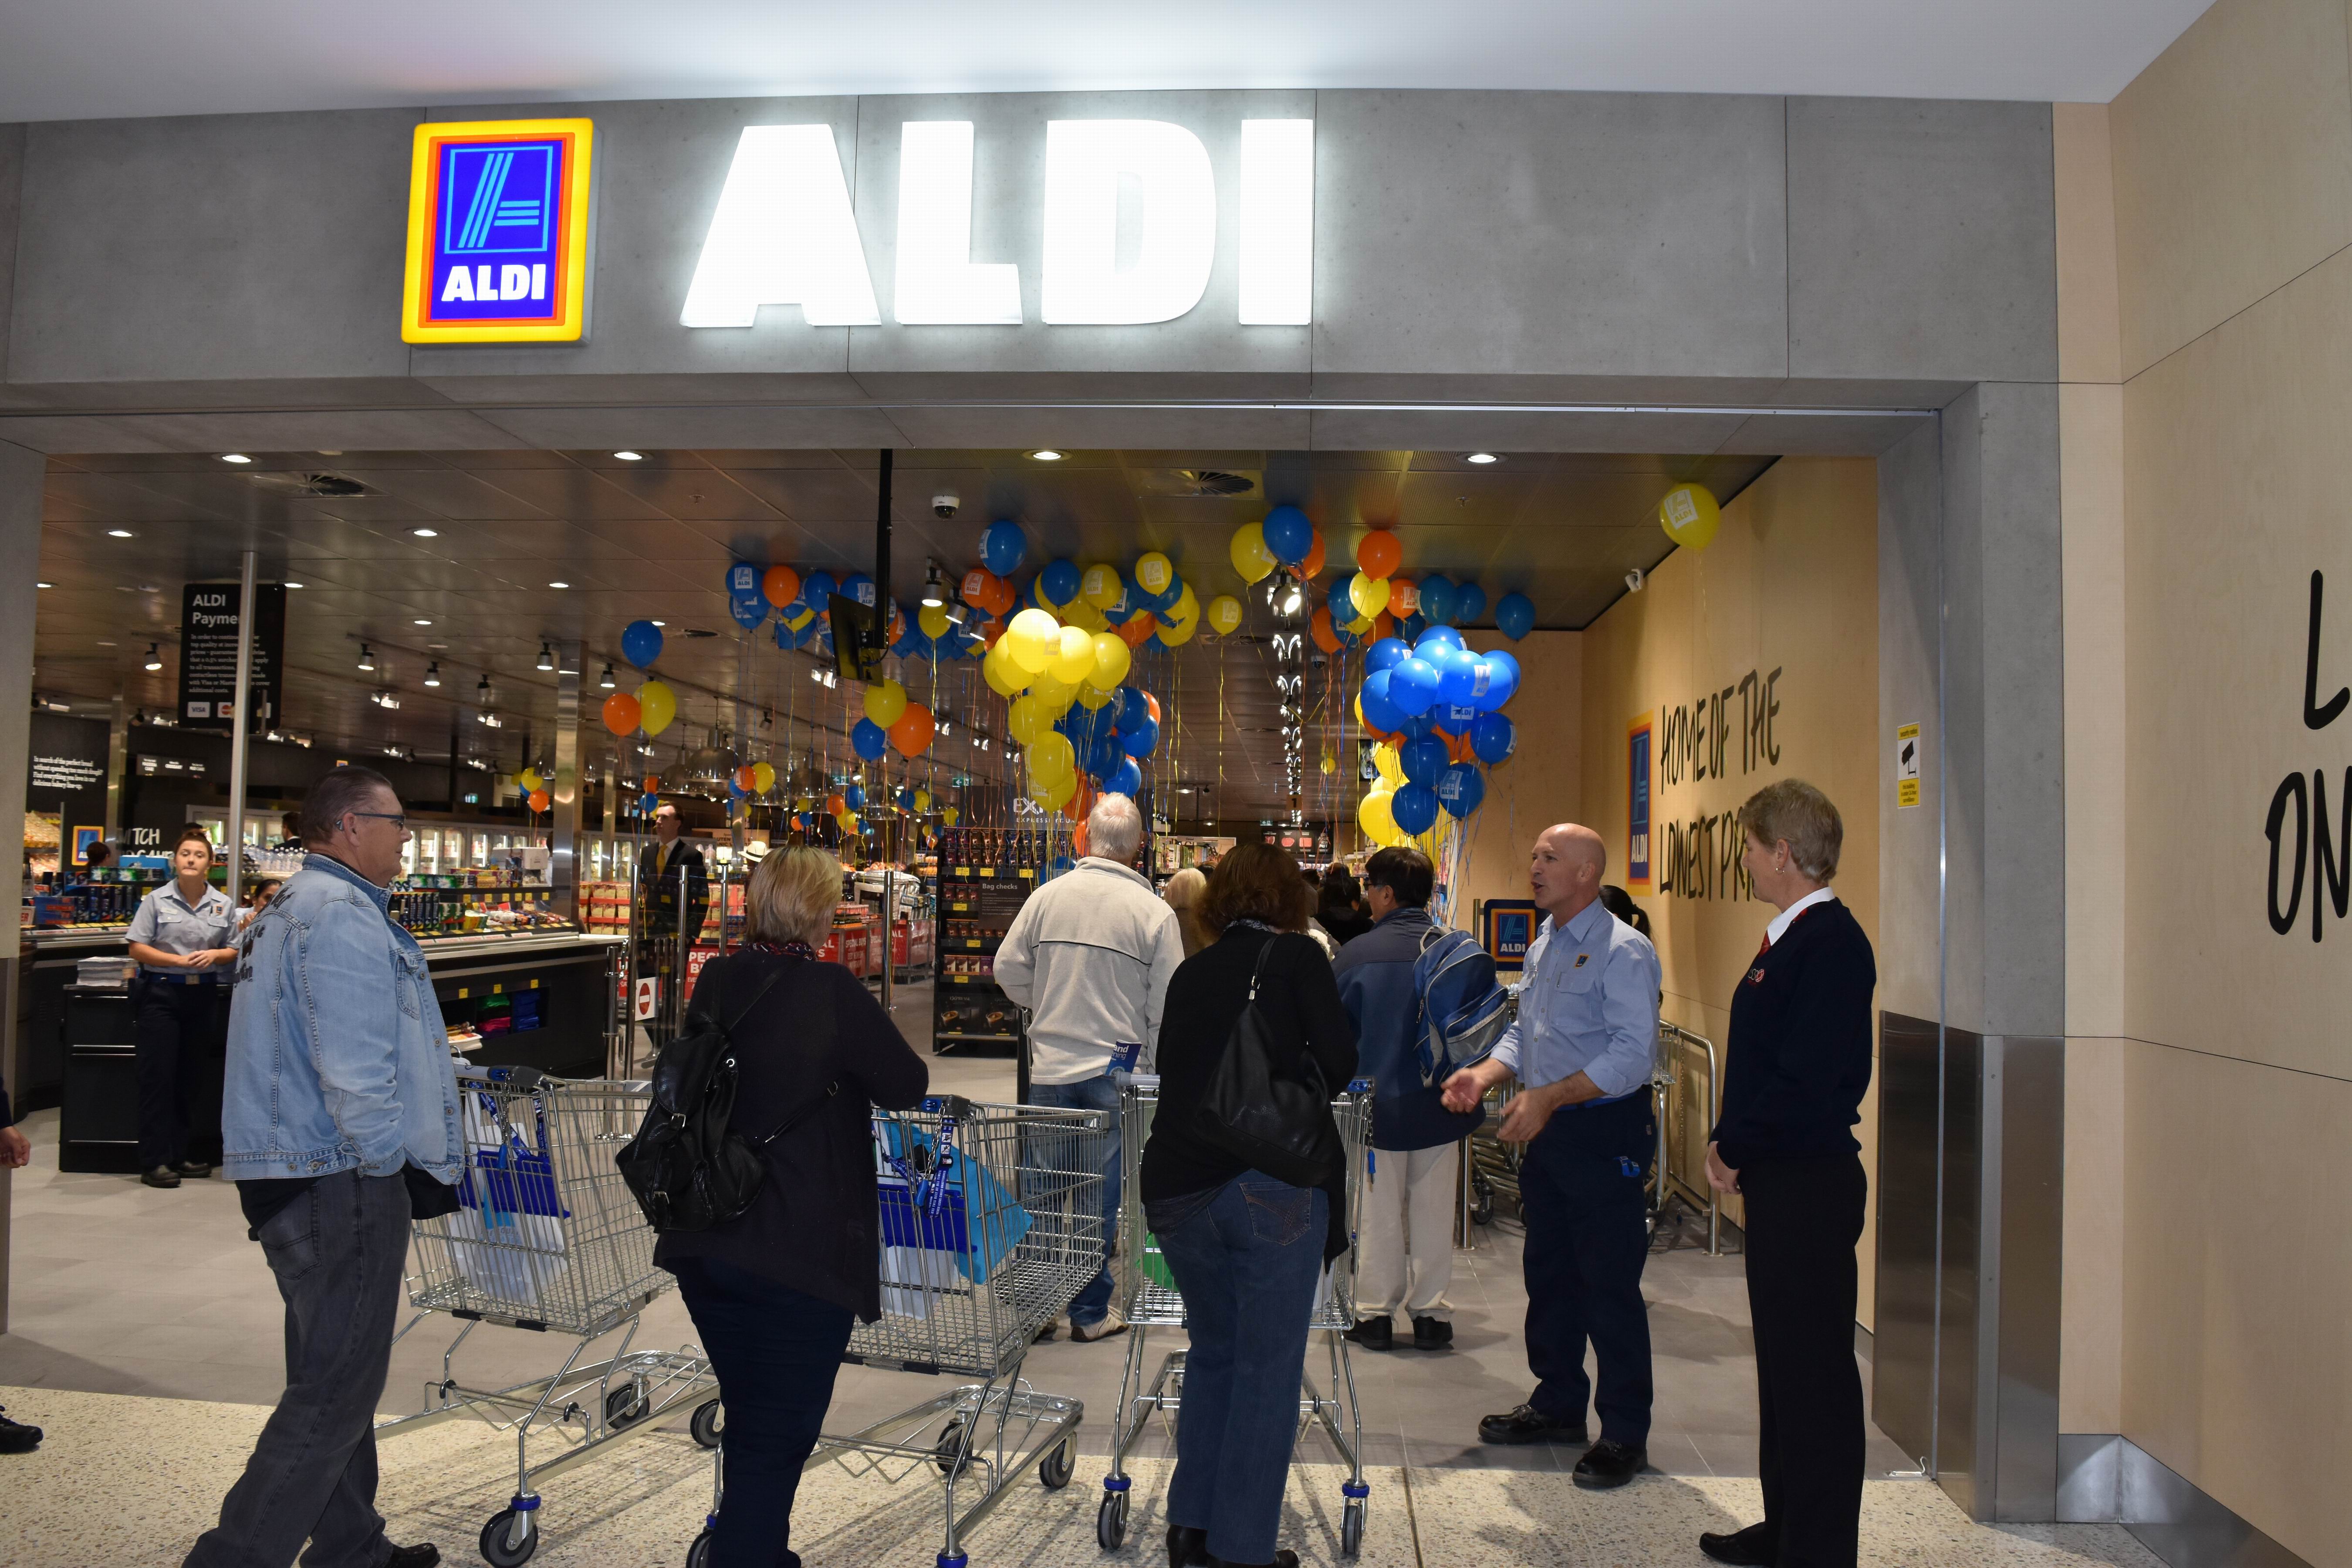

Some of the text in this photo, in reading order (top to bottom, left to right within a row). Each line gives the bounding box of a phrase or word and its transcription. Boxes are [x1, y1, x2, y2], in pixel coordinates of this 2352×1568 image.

[679, 118, 1315, 328] ALDI
[441, 263, 546, 303] ALDI
[1675, 510, 1693, 523] ALDI
[193, 595, 226, 606] ALDI
[193, 612, 239, 628] Payme
[1660, 666, 1782, 794] HOME OF THE
[1292, 798, 1297, 808] 1
[1631, 834, 1647, 863] ALDI
[1659, 814, 1718, 902] LOWEST
[1500, 943, 1526, 952] ALDI
